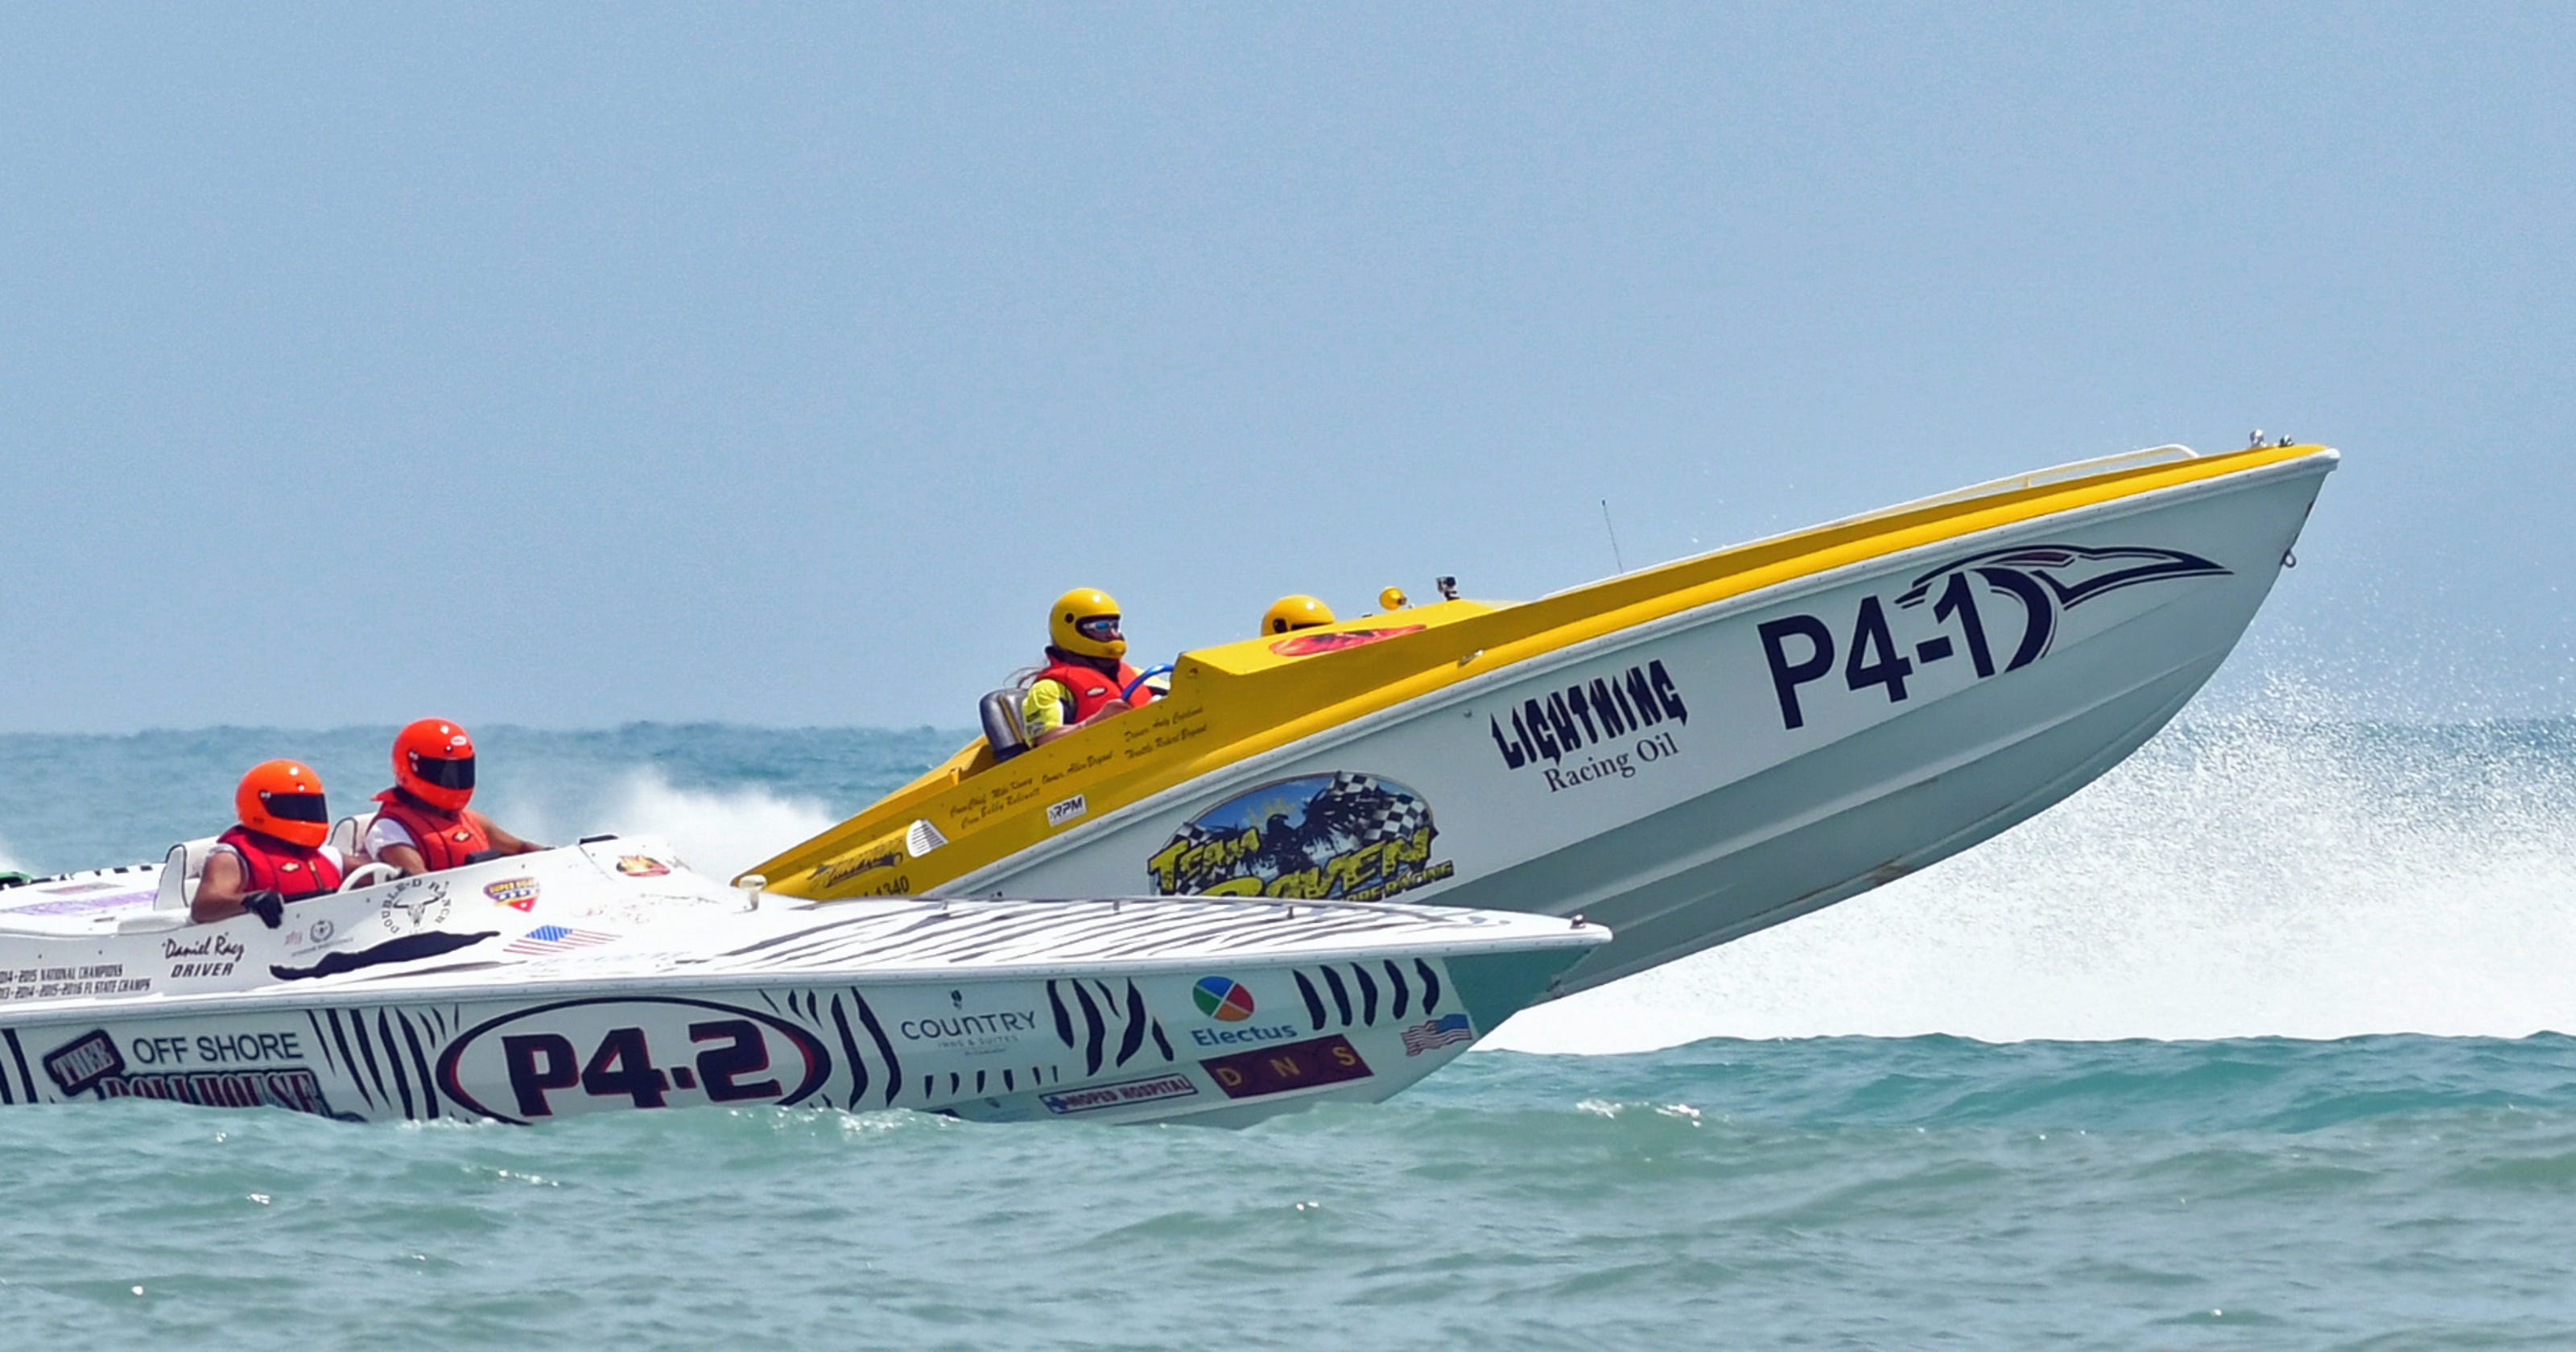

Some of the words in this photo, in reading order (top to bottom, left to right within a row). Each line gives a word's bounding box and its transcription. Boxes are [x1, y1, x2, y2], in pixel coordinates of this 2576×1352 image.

[1757, 571, 1996, 730] P4-1
[1490, 659, 1687, 770] LIGHTNING
[1542, 752, 1636, 793] Racing
[1637, 732, 1679, 761] Oil
[1051, 797, 1082, 818] RPM
[165, 935, 212, 959] Daniel
[41, 967, 76, 981] NATIONAL
[78, 964, 123, 979] CHAMPIONS
[171, 962, 234, 978] DRIVER
[93, 979, 117, 995] STATE
[117, 978, 151, 993] CHAMPS
[901, 1011, 1035, 1040] COUNTRY
[1191, 1024, 1298, 1046] Electus
[132, 1036, 188, 1065] OFF
[196, 1032, 304, 1063] SHORE
[501, 1019, 782, 1116] P4-2
[1216, 1067, 1242, 1086] D
[1269, 1056, 1301, 1078] N
[1333, 1046, 1356, 1067] S
[1066, 1089, 1118, 1107] MOPED
[1119, 1078, 1188, 1099] HOSPITAL
